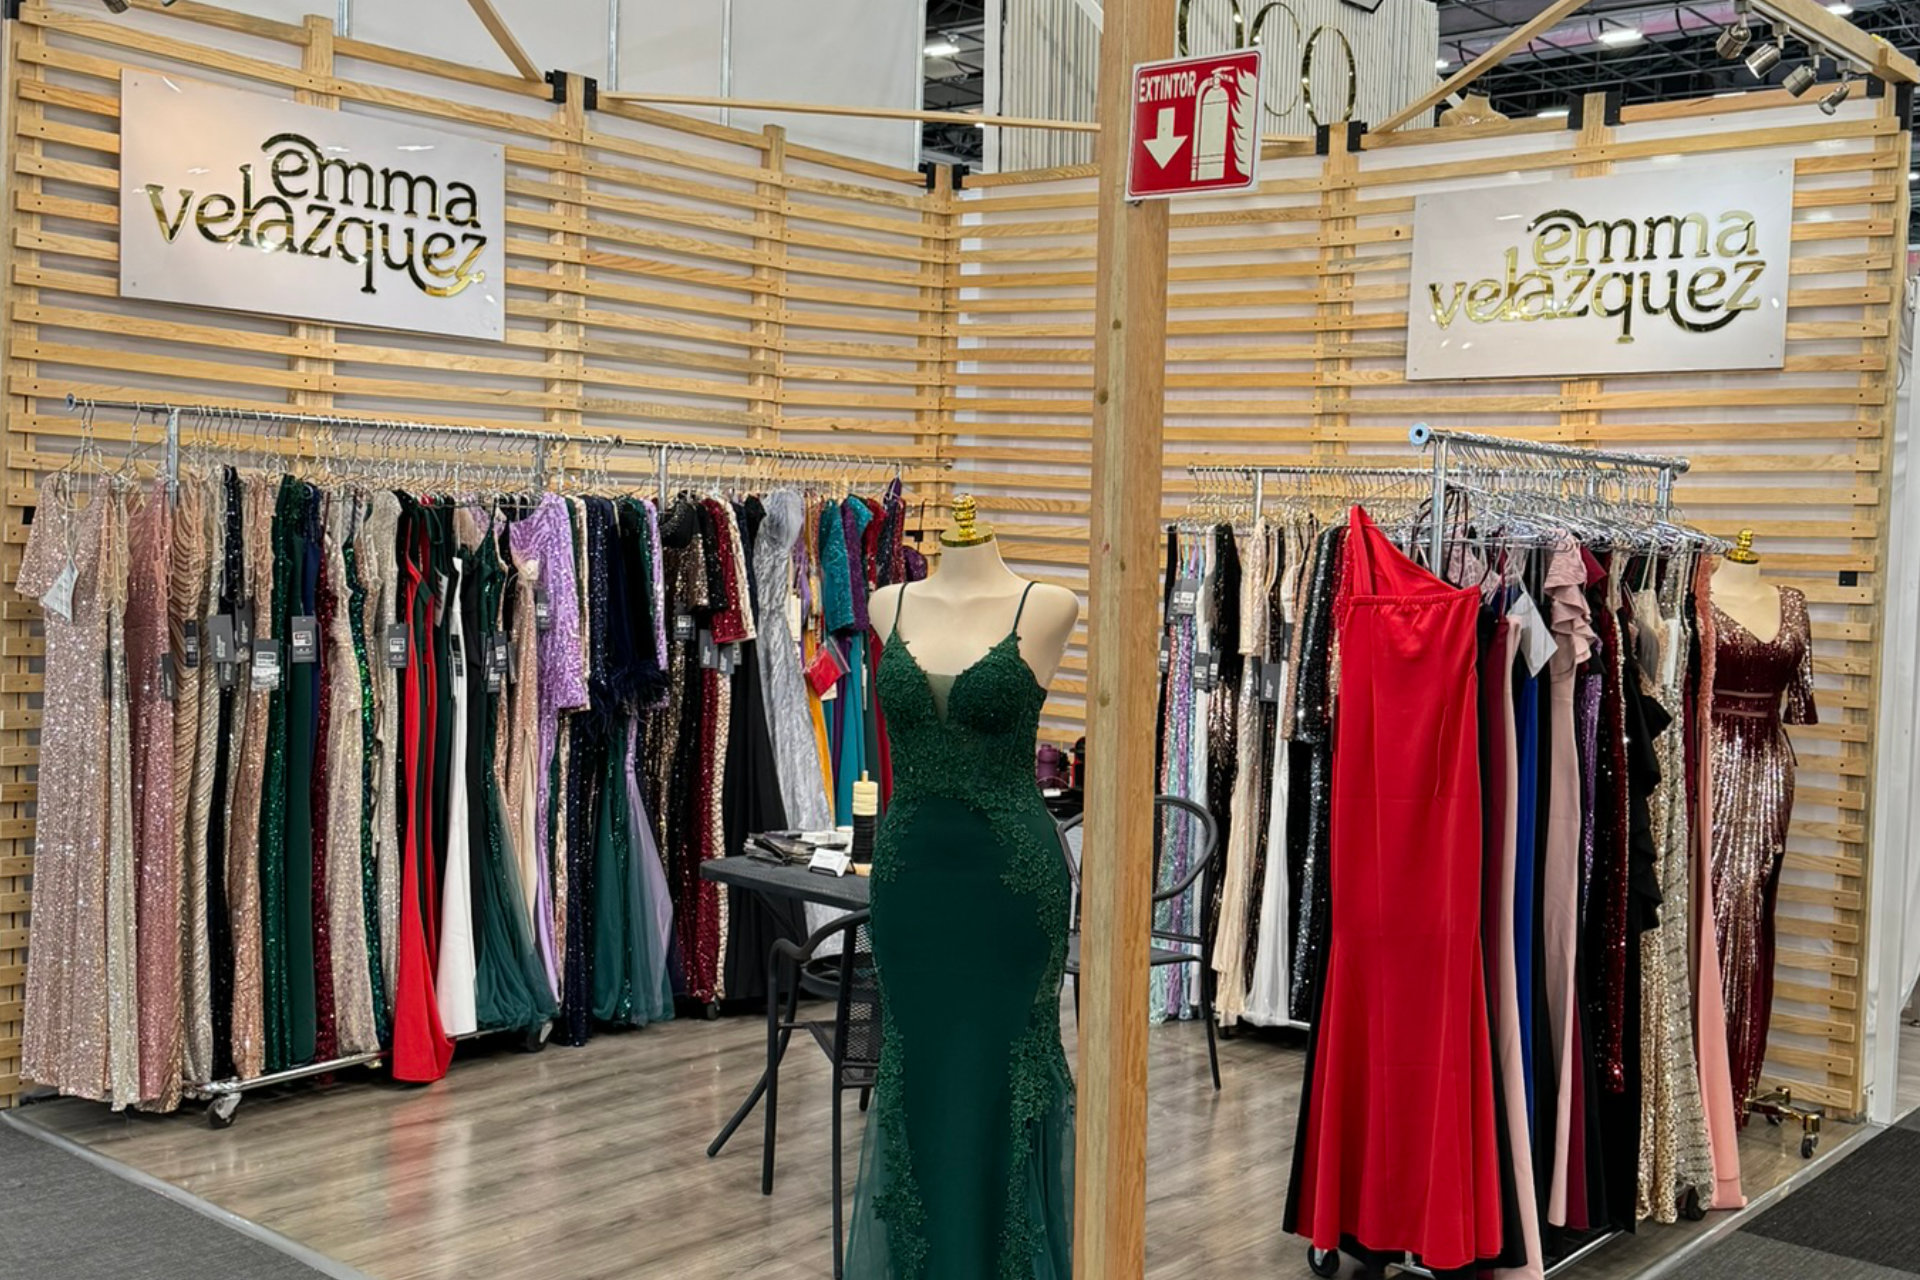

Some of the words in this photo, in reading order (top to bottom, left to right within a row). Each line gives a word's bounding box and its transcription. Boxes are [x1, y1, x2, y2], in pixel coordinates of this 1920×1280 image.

[1138, 70, 1197, 103] EXTINTOR
[261, 132, 482, 229] emma
[145, 164, 488, 298] velazquez
[1526, 208, 1760, 271] emma
[1428, 246, 1767, 344] velazquez
